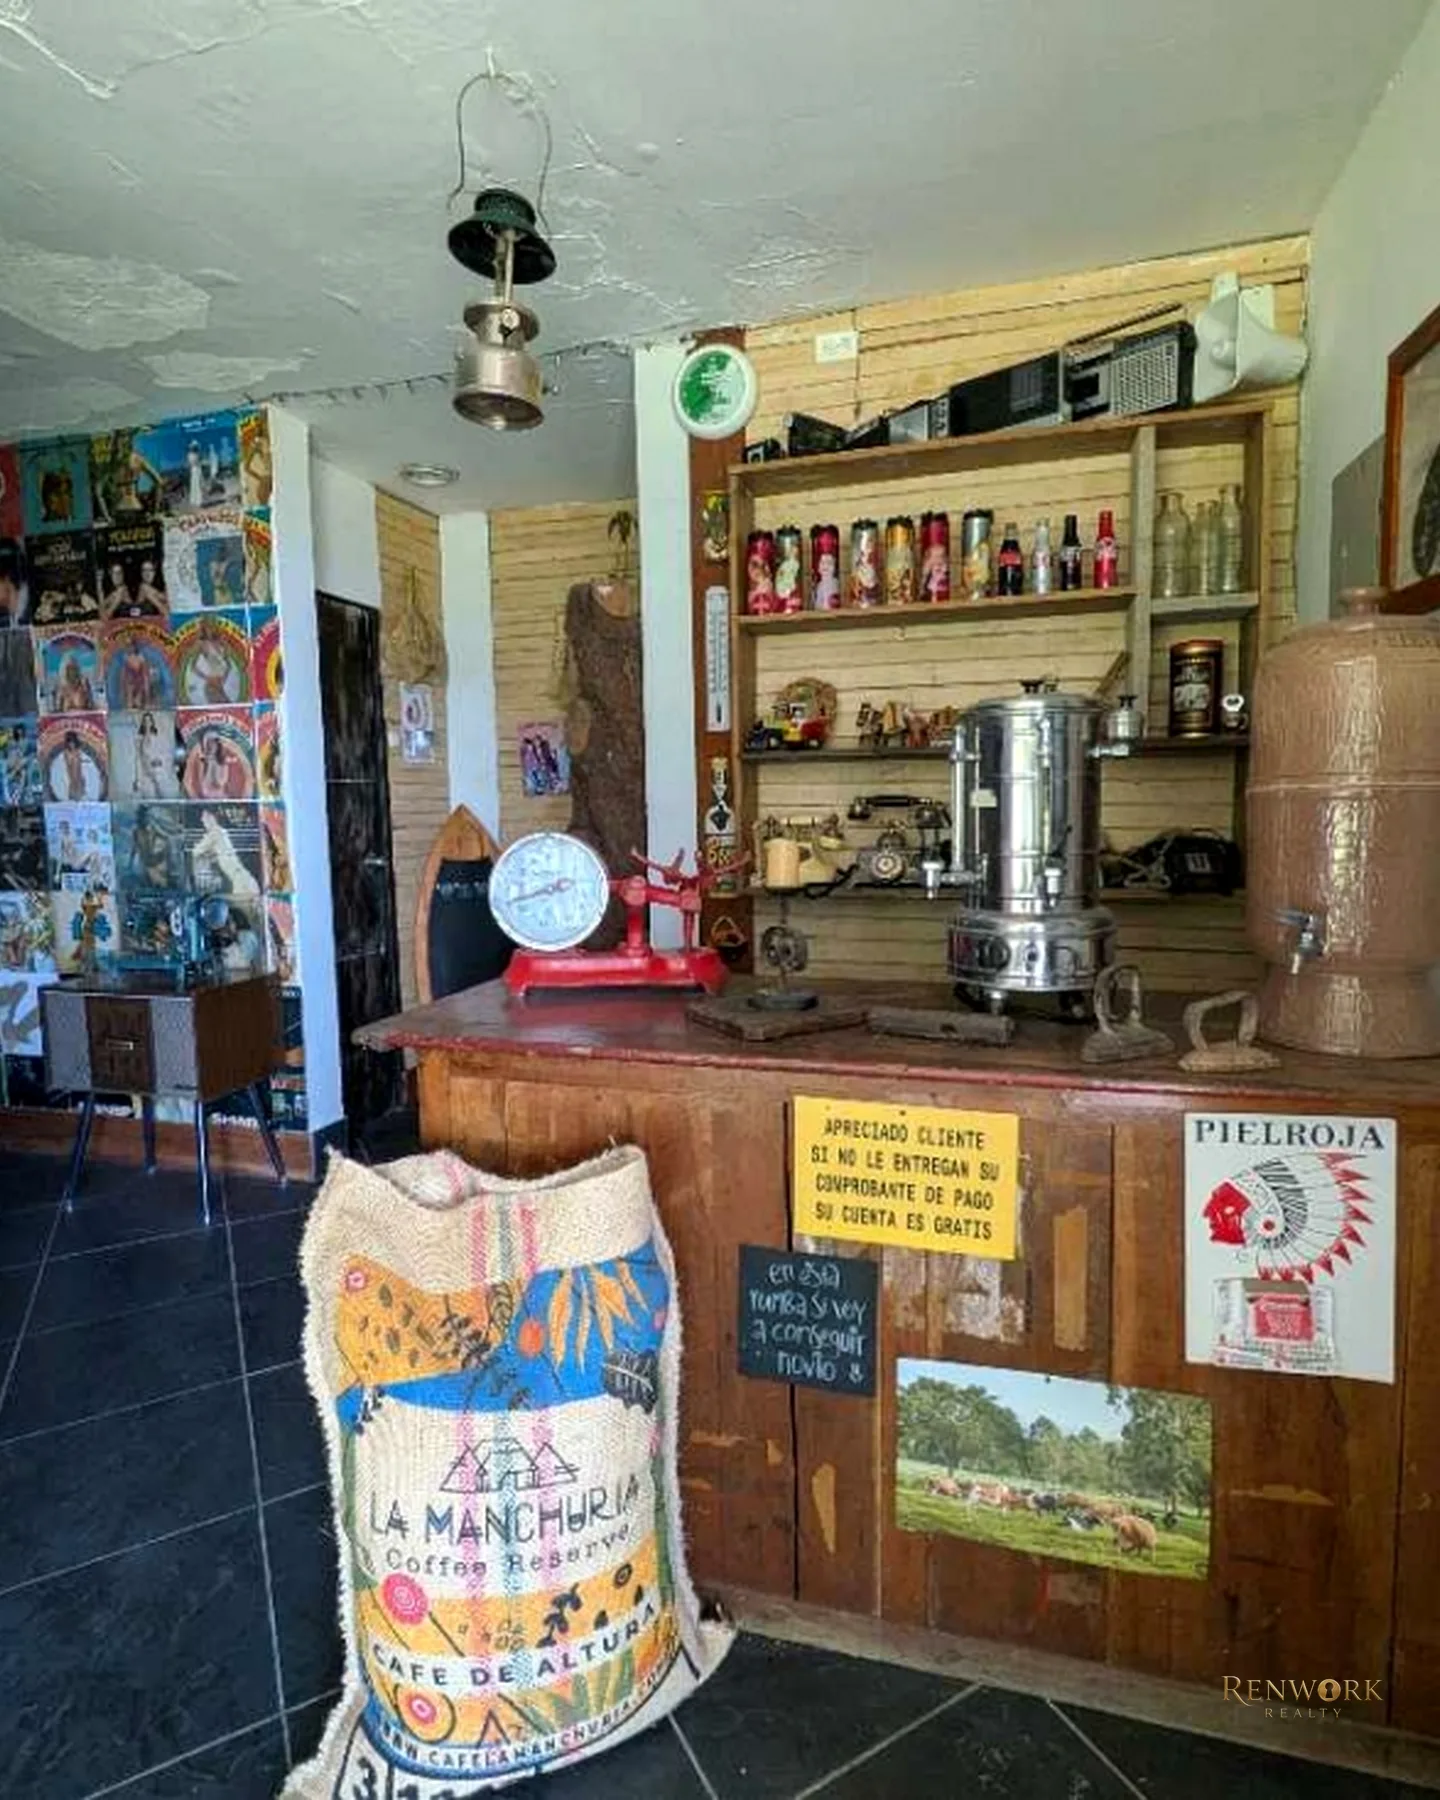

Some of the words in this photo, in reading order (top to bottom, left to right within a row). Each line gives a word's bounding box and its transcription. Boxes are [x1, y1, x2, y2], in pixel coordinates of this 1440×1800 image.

[825, 1118, 908, 1143] APRECIADO
[918, 1126, 986, 1150] CLIENTE
[1194, 1119, 1385, 1150] PIELROJA
[811, 1145, 828, 1163] SI
[838, 1148, 857, 1167] NO
[866, 1150, 884, 1170] LE
[893, 1153, 969, 1178] ENTREGAN
[979, 1161, 1000, 1181] SU
[815, 1173, 916, 1202] COMPROBANTE
[925, 1186, 944, 1205] DE
[954, 1188, 994, 1211] PAGO
[815, 1202, 833, 1221] SU
[841, 1205, 897, 1228] CUENTA
[906, 1213, 925, 1232] ES
[934, 1216, 993, 1240] GRATIS
[370, 1490, 410, 1540] LA
[425, 1474, 641, 1545] MANCHURIA
[386, 1549, 487, 1576] Coffee
[371, 1643, 448, 1686] CAFE
[470, 1666, 514, 1687] DE
[536, 1602, 656, 1679] ALTURA
